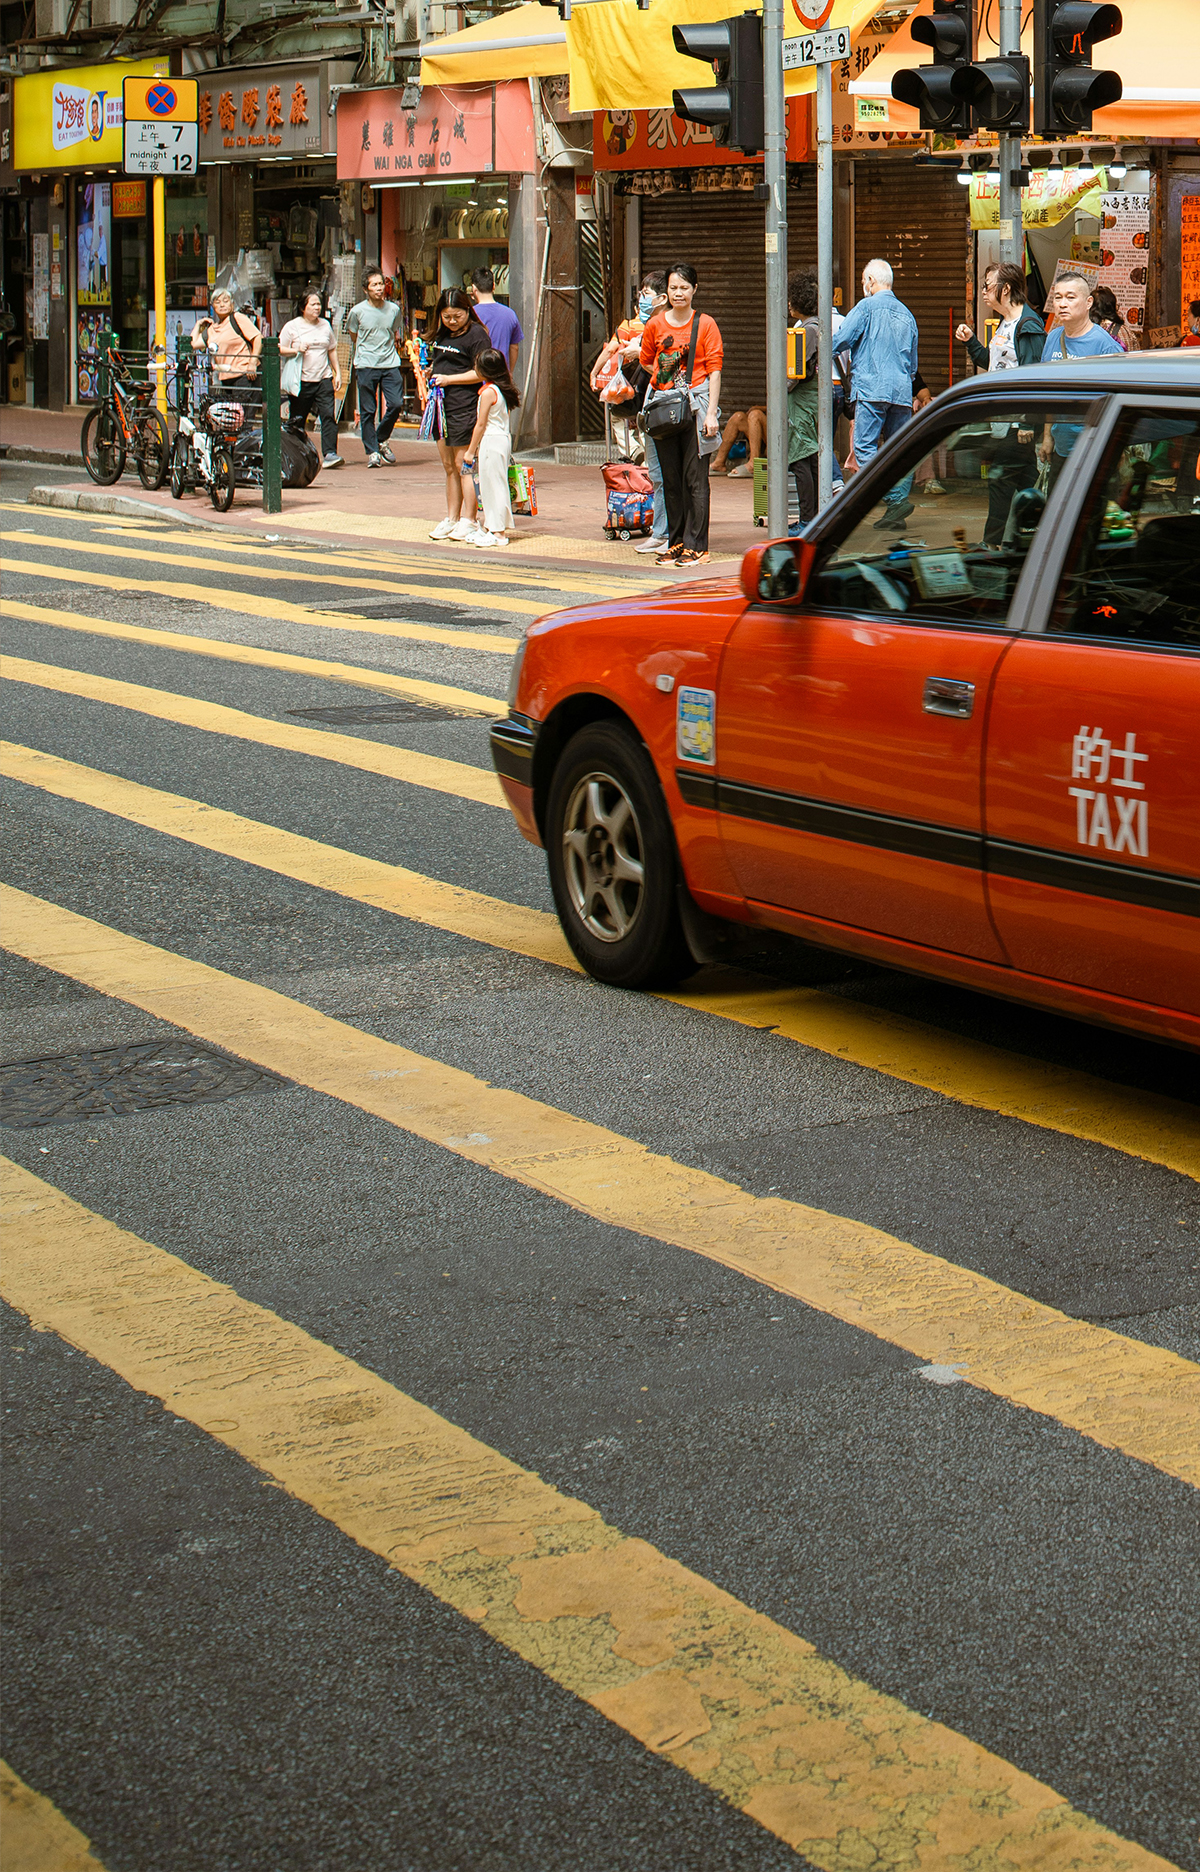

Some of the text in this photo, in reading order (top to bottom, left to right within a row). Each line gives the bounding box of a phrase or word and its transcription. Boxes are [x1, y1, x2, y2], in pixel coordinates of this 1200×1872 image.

[824, 36, 833, 44] pm
[837, 33, 846, 54] 9
[800, 39, 814, 62] 12
[823, 46, 836, 58] 下午
[785, 54, 798, 66] 中午
[58, 132, 69, 142] EAT
[138, 132, 159, 142] 上午
[172, 126, 183, 142] 7
[130, 150, 167, 164] midnight
[172, 154, 192, 171] 12
[374, 151, 451, 170] WAI NGA GEM CO
[138, 161, 160, 171] 午夜
[1072, 725, 1149, 790] 的士
[1068, 786, 1149, 858] TAXI
